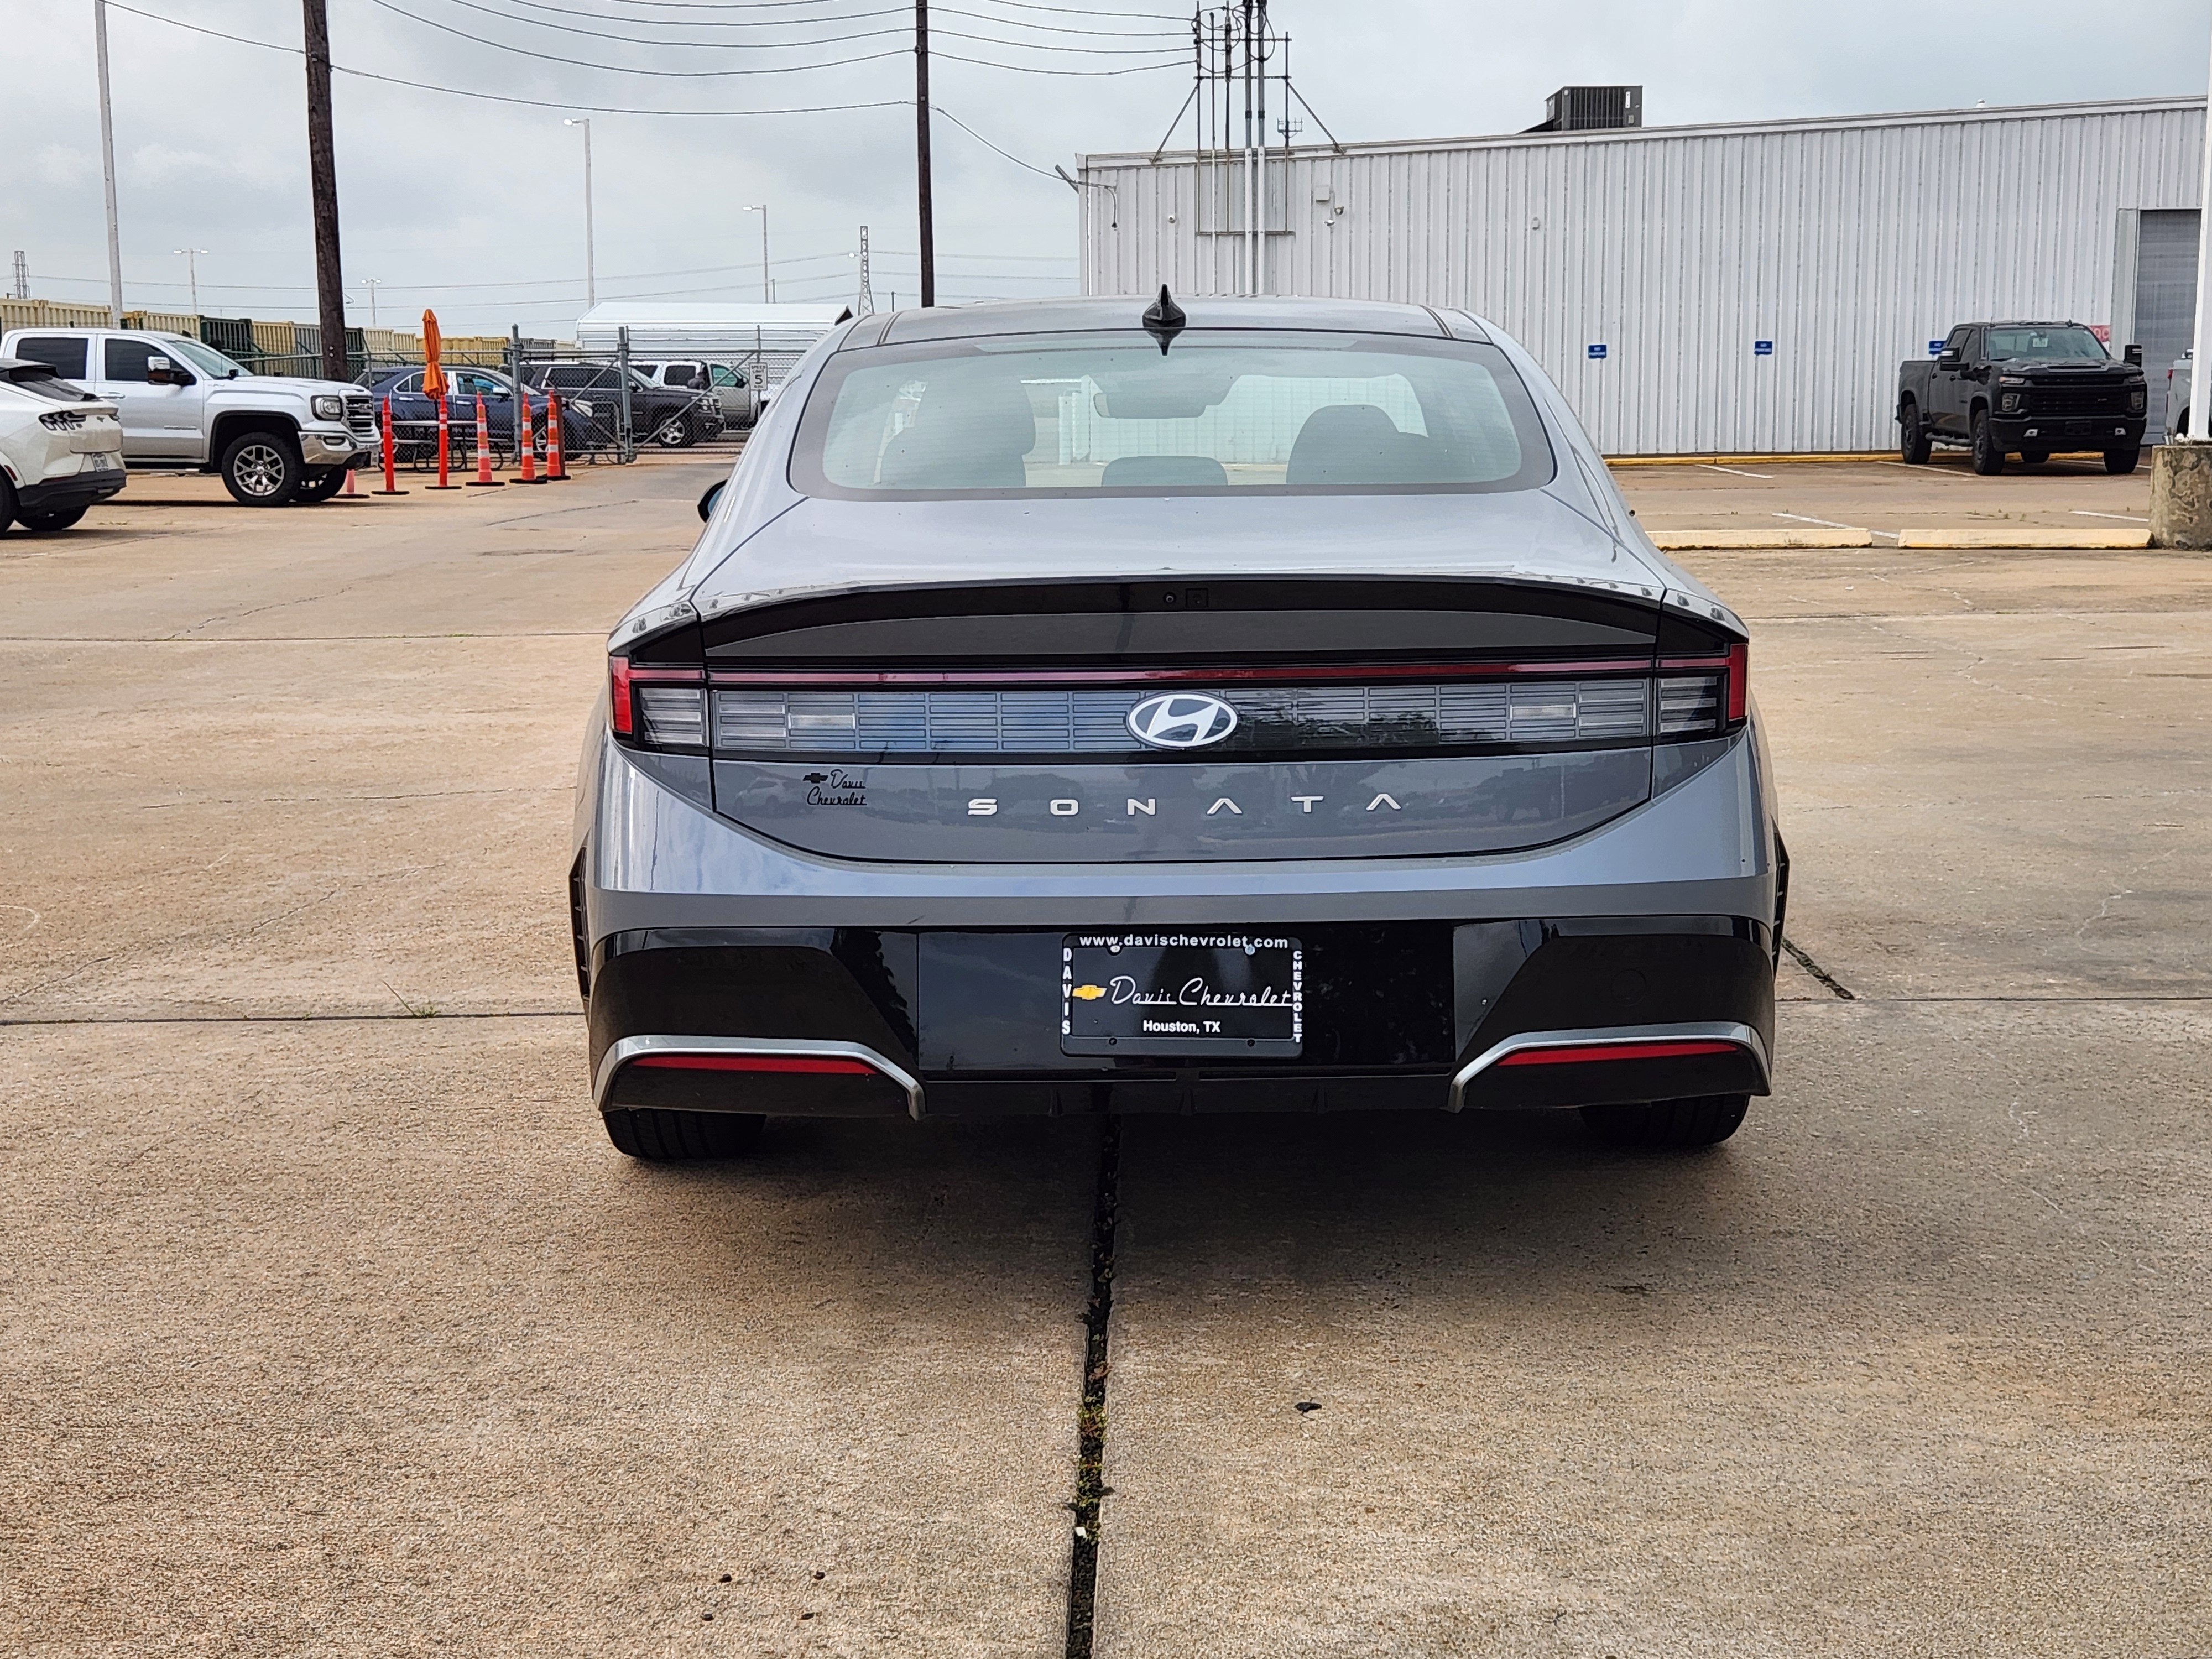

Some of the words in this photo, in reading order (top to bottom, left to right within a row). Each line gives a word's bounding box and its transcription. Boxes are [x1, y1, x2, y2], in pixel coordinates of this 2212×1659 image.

[755, 374, 763, 385] 5
[807, 786, 868, 805] Chevrolet
[967, 794, 1402, 816] SONATA
[1079, 933, 1288, 948] www.davischevrolet.com
[1062, 947, 1072, 1035] DAVIS
[1109, 975, 1177, 1005] Davis
[1178, 977, 1293, 1006] Chevrolet
[1292, 950, 1303, 1043] CHEVROLET
[1143, 1019, 1200, 1034] Houston,
[1203, 1020, 1221, 1033] TX
